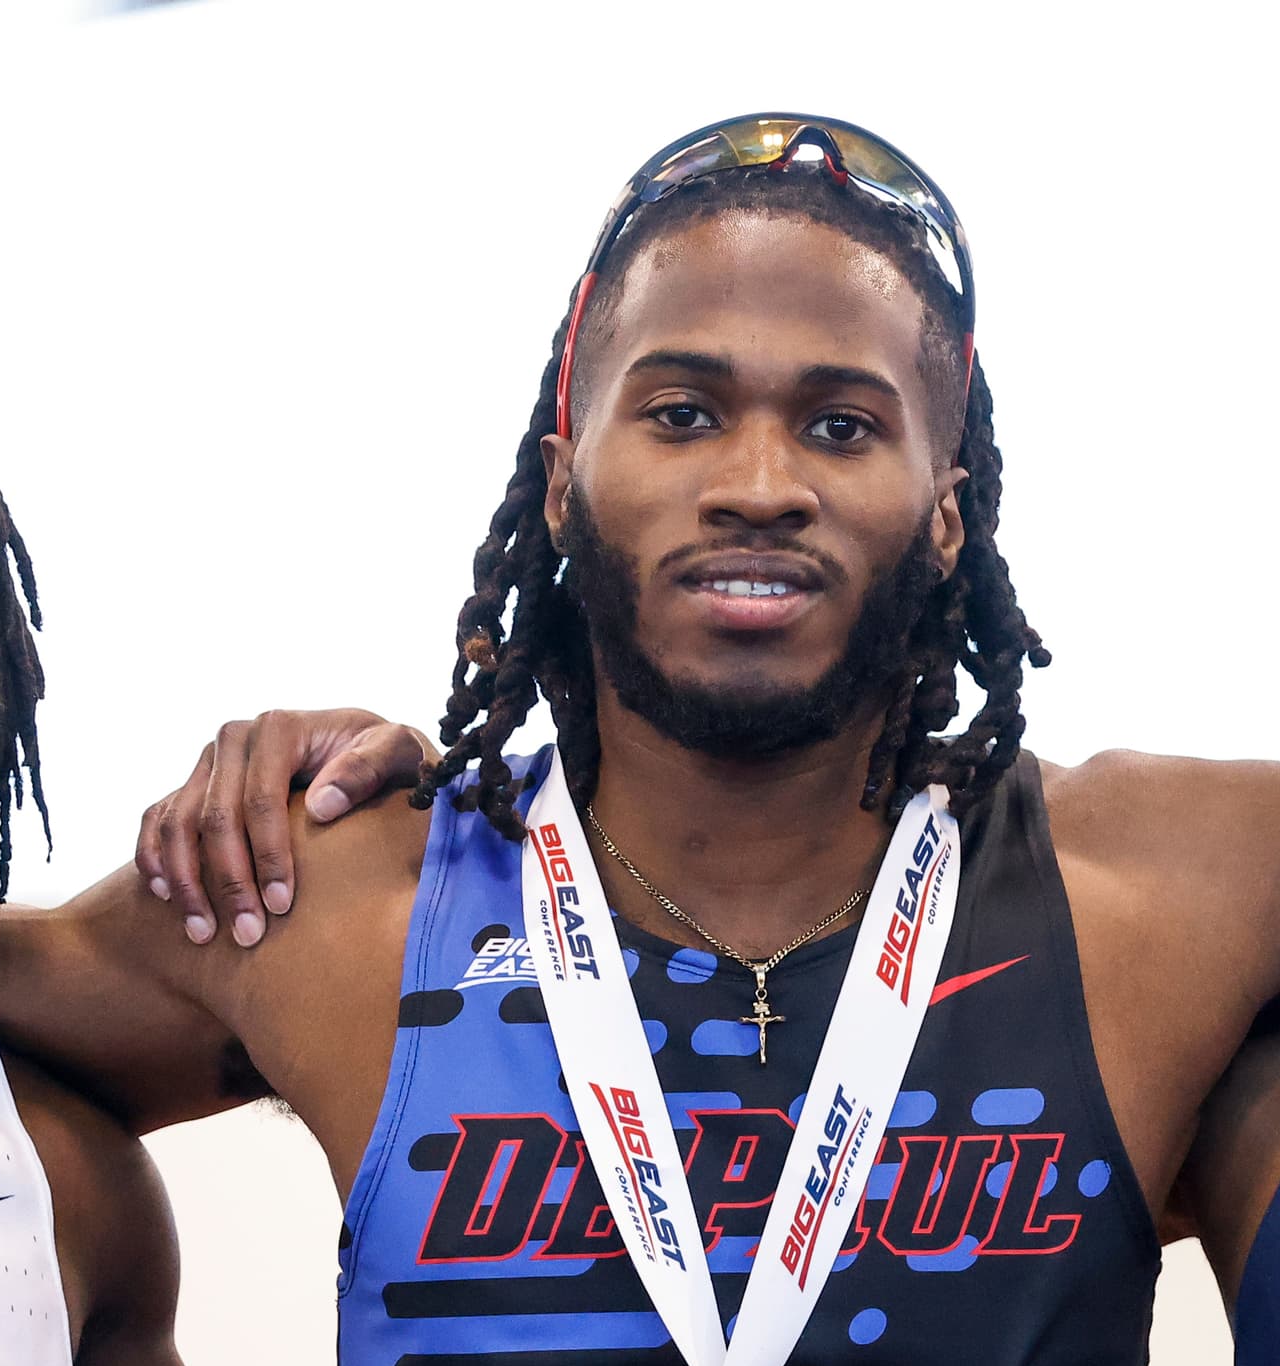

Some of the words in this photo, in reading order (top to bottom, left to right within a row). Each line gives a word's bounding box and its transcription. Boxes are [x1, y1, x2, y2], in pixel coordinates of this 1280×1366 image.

[928, 843, 952, 925] CONFERENCE
[540, 900, 564, 981] CONFERENCE
[834, 1107, 873, 1206] CONFERENCE
[615, 1167, 655, 1263] CONFERENCE
